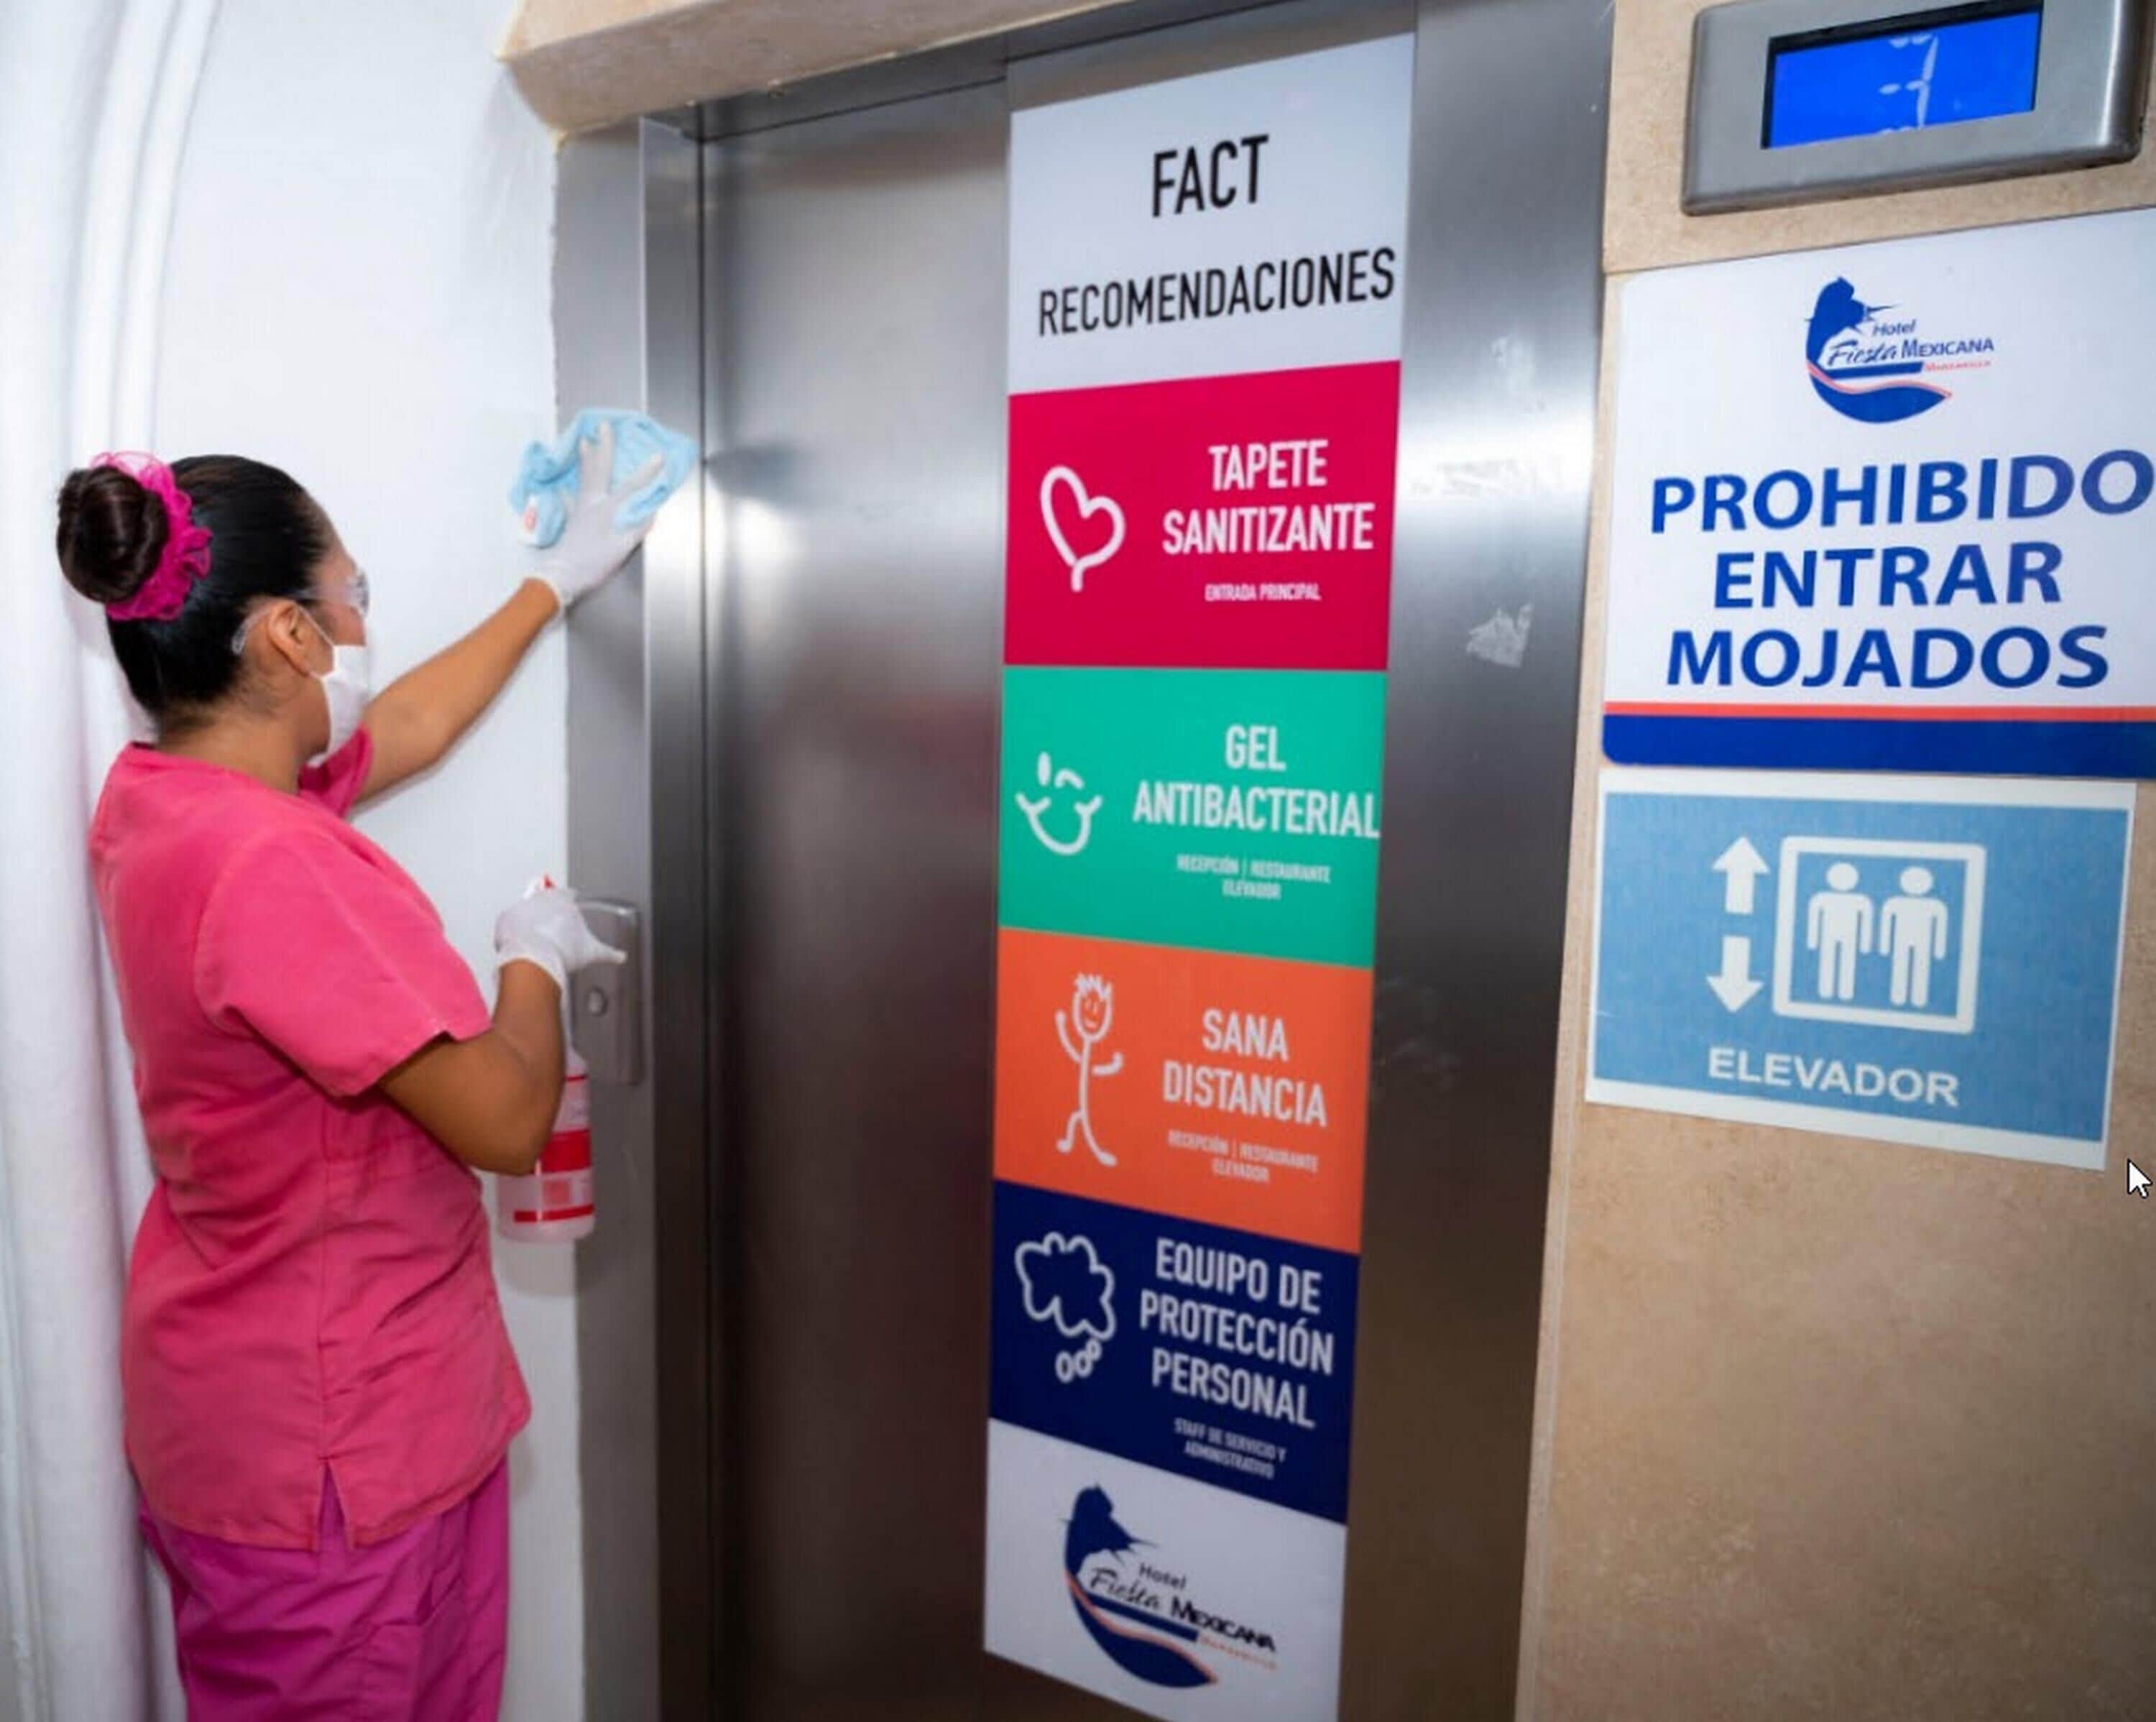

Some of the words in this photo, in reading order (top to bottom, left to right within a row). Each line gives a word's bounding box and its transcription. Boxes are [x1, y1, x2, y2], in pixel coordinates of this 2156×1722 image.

[1153, 134, 1269, 217] FACT
[1039, 247, 1396, 336] RECOMENDACIONES
[1828, 339, 1897, 366] Fiesta
[1901, 337, 1995, 359] MEXICANA
[1872, 319, 1917, 336] Hotel
[1209, 439, 1328, 491] TAPETE
[1651, 449, 2155, 533] PROHIBIDO
[1162, 503, 1376, 555] SANITIZANTE
[1204, 583, 1257, 602] ENTRADA
[1259, 582, 1322, 601] PRINCIPAL
[1714, 541, 2063, 609] ENTRAR
[1667, 625, 2109, 689] MOJADOS
[1225, 724, 1286, 771] GEL
[1132, 781, 1381, 839] ANTIBACTERIAL
[1202, 1008, 1289, 1062] SANA
[1163, 1060, 1327, 1128] DISTANCIA
[1708, 1046, 1959, 1108] ELEVADOR
[1156, 1236, 1269, 1302] EQUIPO
[1279, 1265, 1323, 1314] DE
[1140, 1289, 1335, 1376] PROTECCIÓN
[1151, 1348, 1317, 1430] PERSONAL
[1139, 1563, 1187, 1590] Hotel
